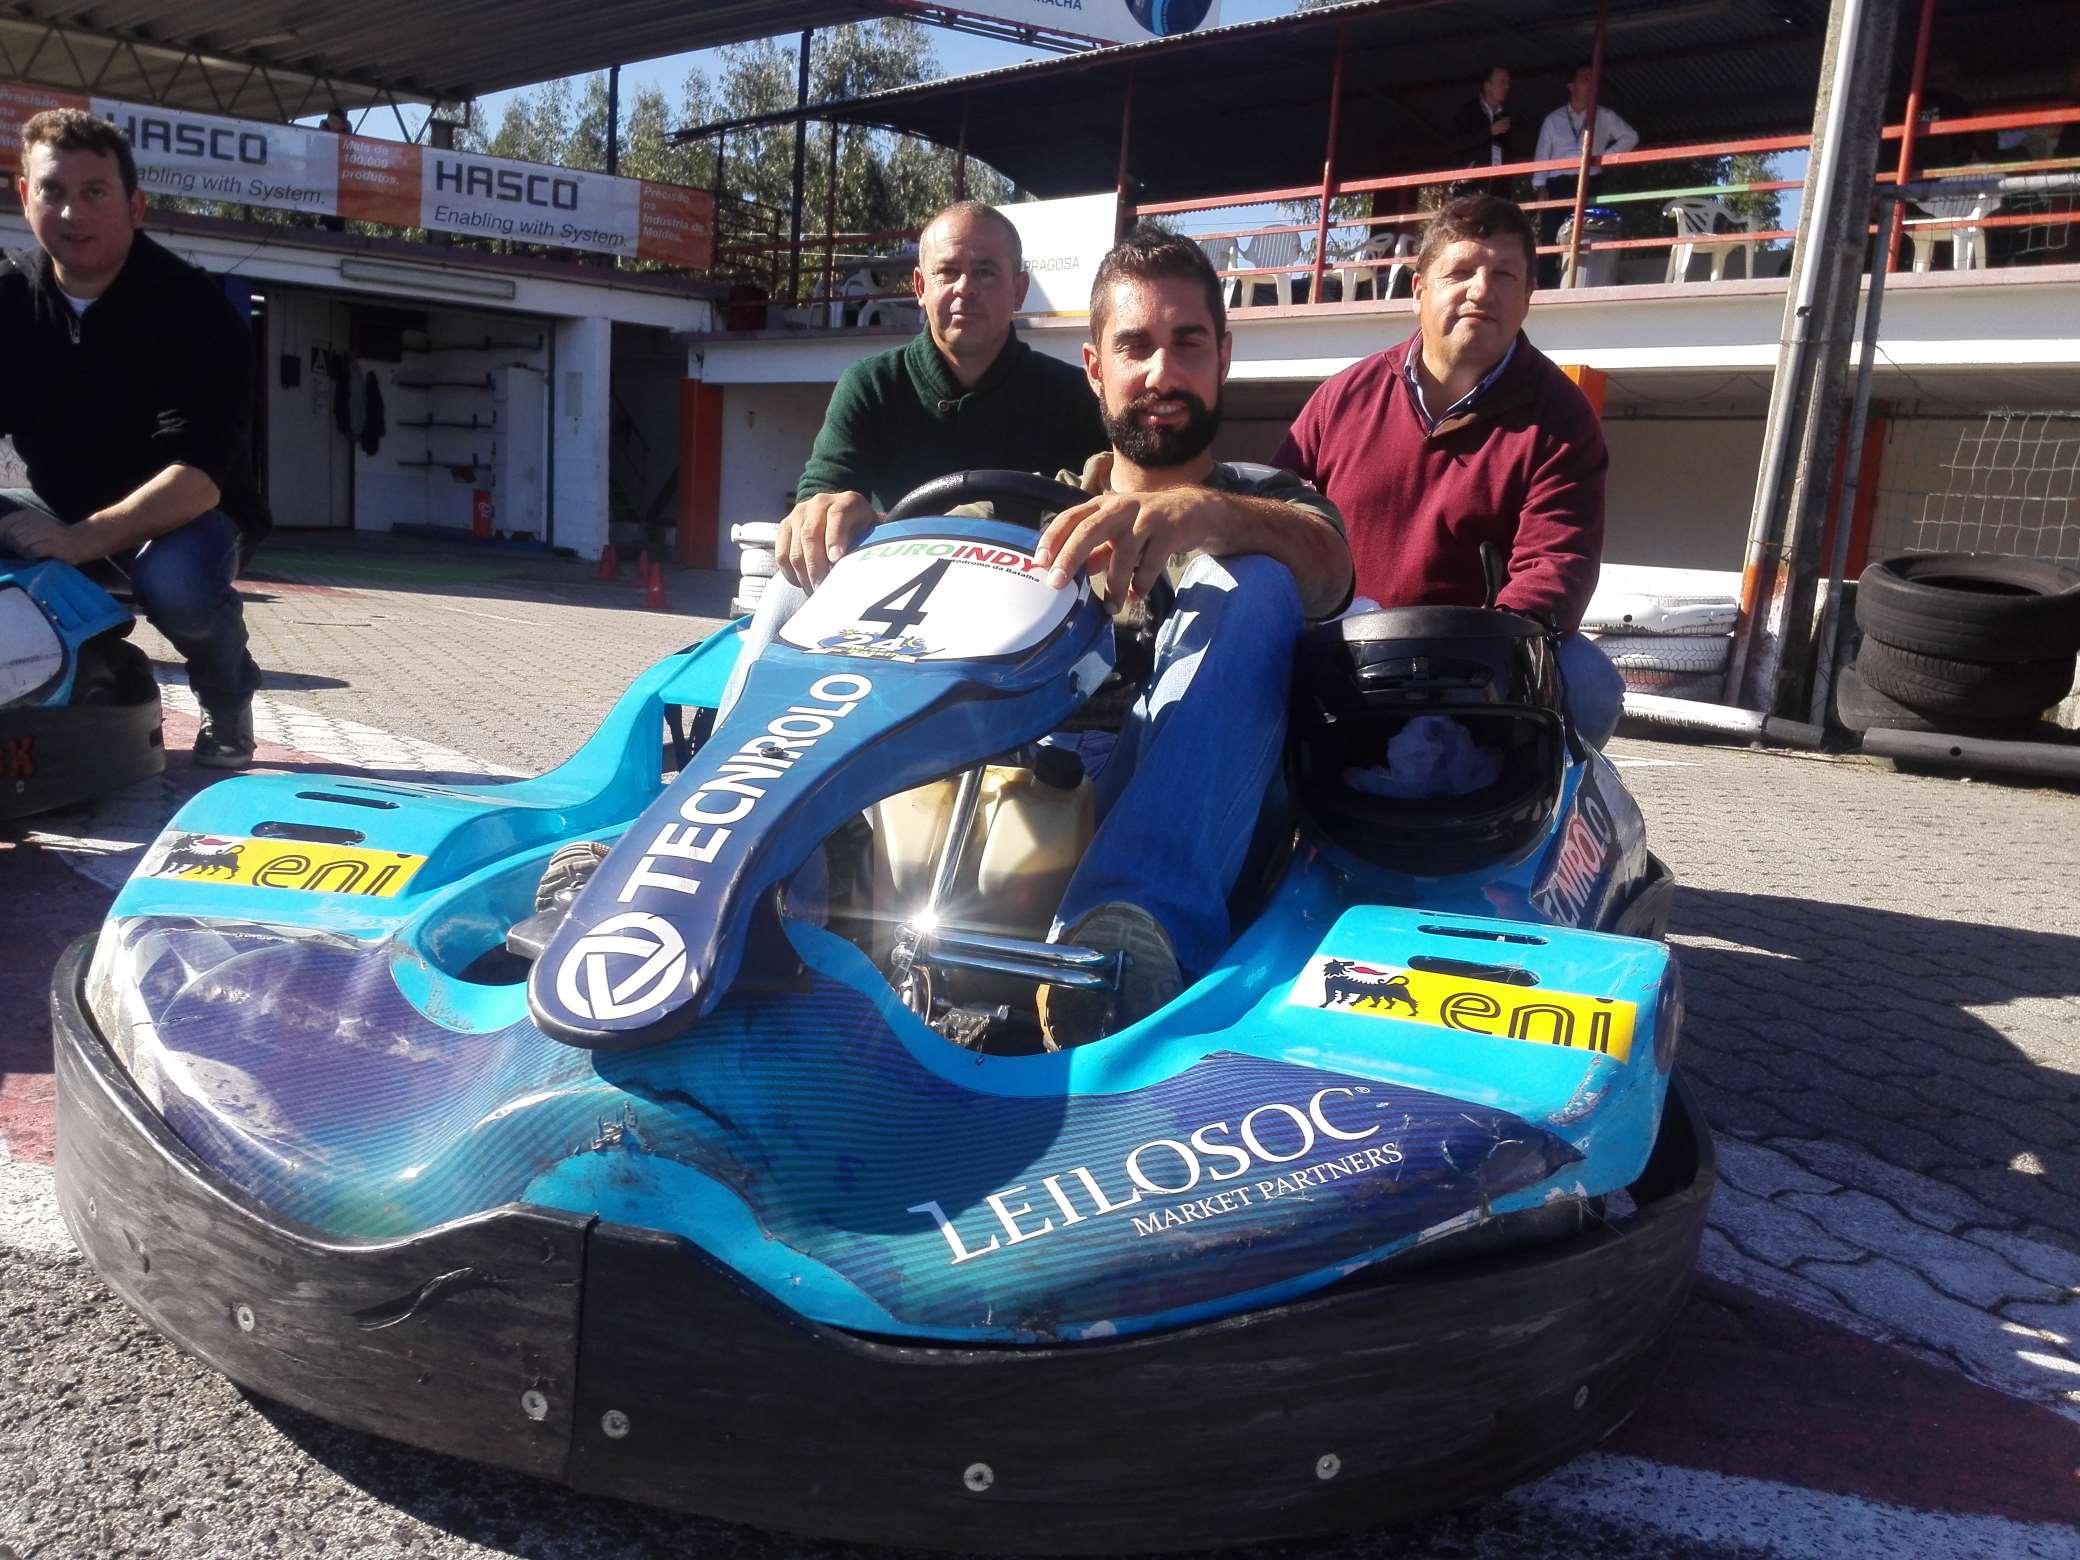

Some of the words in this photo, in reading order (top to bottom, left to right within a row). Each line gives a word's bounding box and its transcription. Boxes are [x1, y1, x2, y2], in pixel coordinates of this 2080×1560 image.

[137, 165, 195, 191] abling
[203, 176, 241, 193] with
[248, 179, 325, 204] System.
[436, 160, 578, 210] HASCO
[434, 205, 514, 234] Enabling
[520, 219, 554, 236] with
[560, 223, 626, 247] System.
[858, 557, 953, 639] 4
[1005, 567, 1041, 583] Batalha
[617, 673, 872, 903] TECNIROLO
[251, 853, 412, 896] eni
[1440, 992, 1614, 1054] eni
[907, 1087, 1380, 1265] LEILOSOC
[1130, 1187, 1253, 1238] MARKET
[1256, 1142, 1404, 1201] PARTNERS
